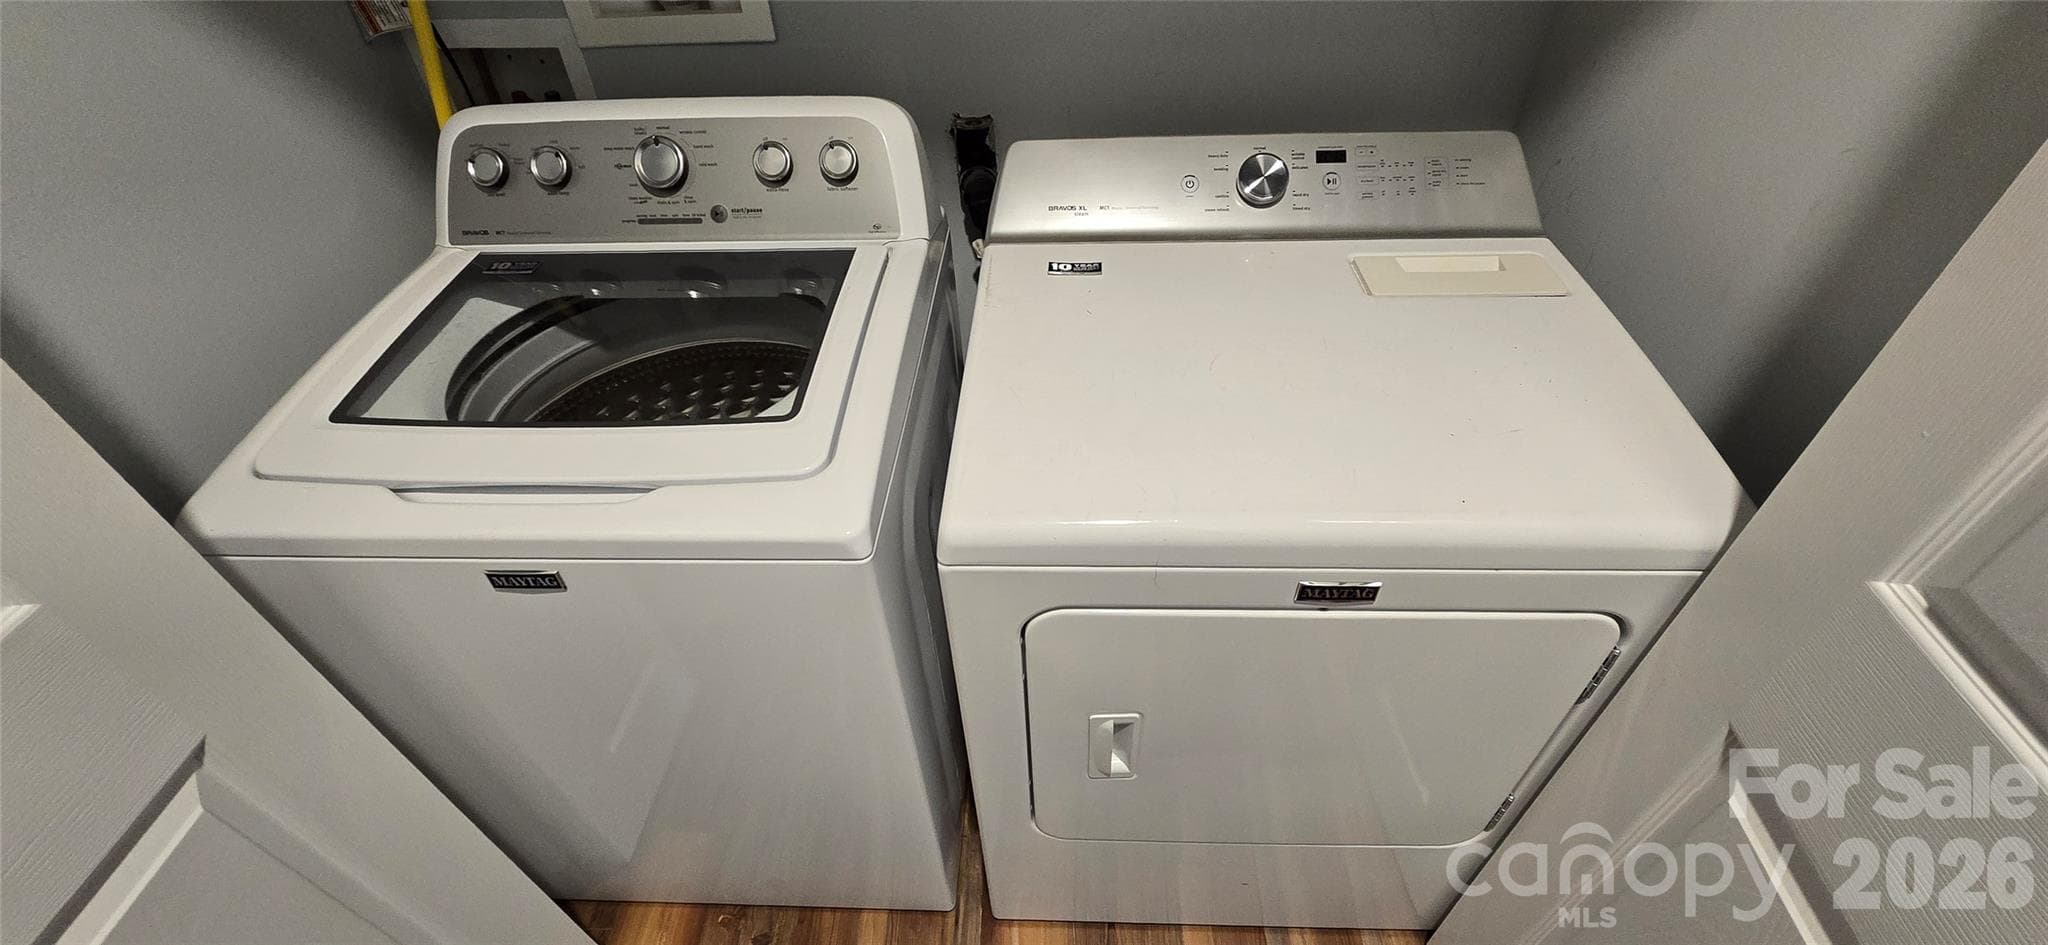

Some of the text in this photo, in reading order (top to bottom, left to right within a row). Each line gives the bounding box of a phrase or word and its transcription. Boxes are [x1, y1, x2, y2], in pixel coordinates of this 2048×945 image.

[490, 262, 511, 270] 10
[1051, 262, 1072, 271] 10
[491, 576, 558, 586] MAYTAG
[1301, 588, 1373, 599] MAYTAG
